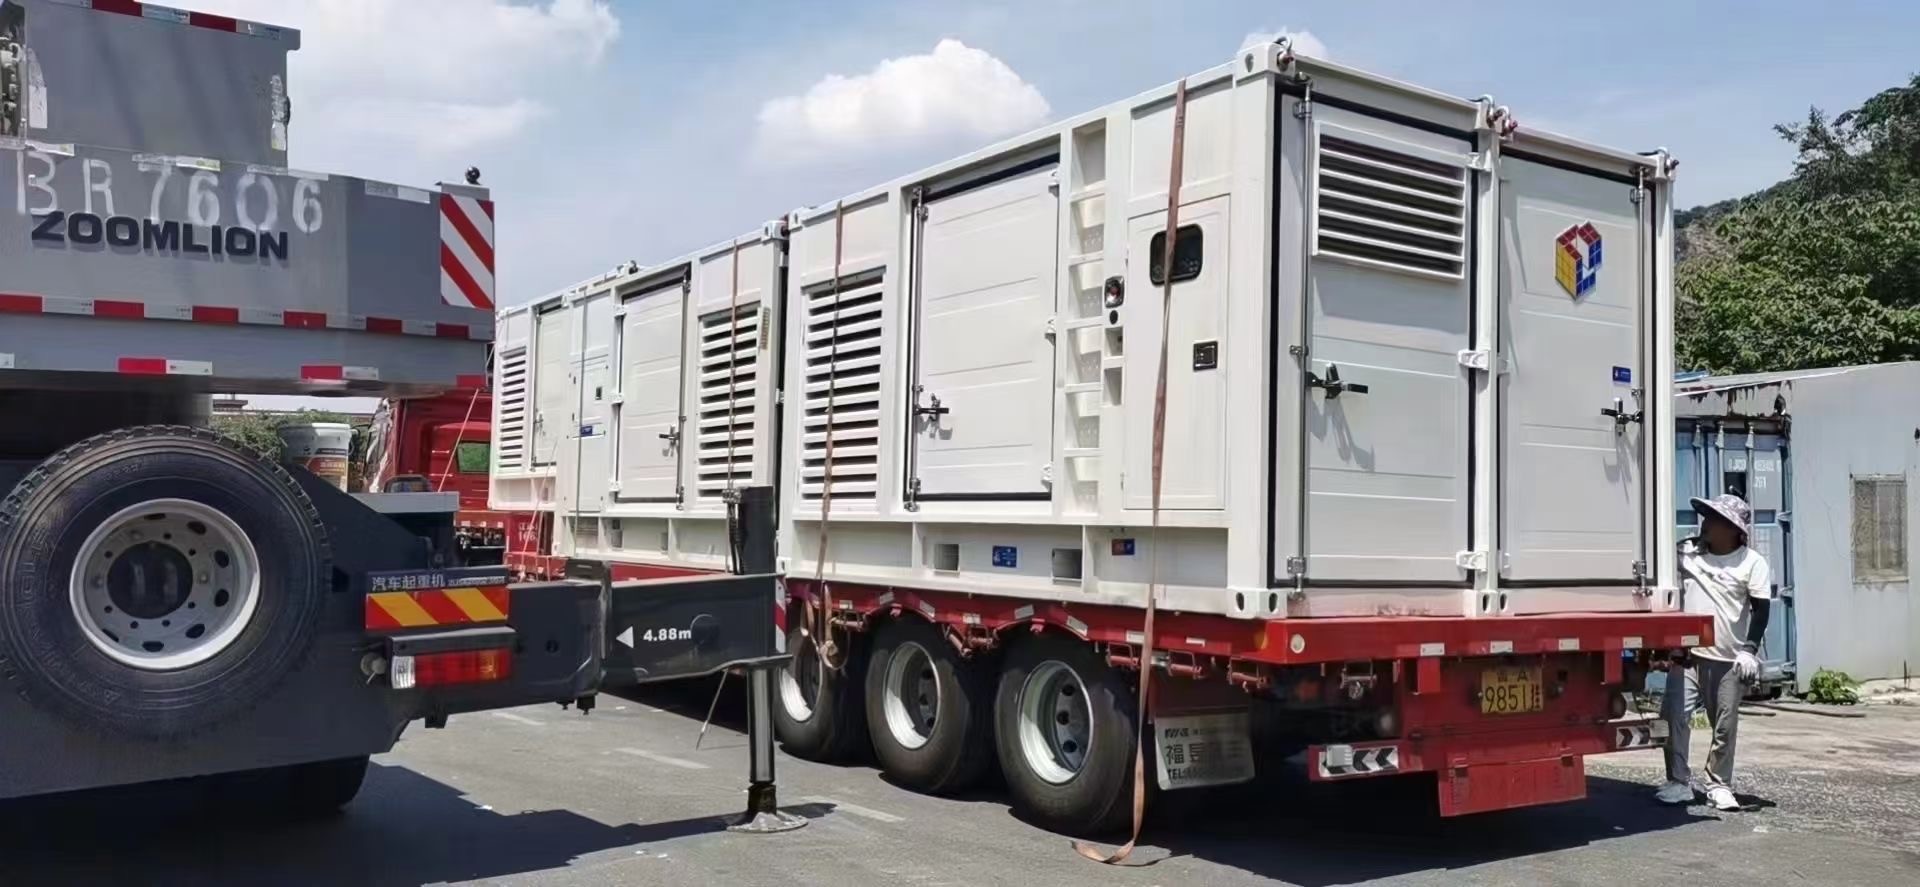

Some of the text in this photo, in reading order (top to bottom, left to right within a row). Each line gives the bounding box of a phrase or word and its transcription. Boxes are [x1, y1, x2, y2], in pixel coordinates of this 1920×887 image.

[31, 210, 288, 261] ZOOMLION
[372, 574, 446, 591] 汽车起重机
[643, 628, 692, 641] 4.88m
